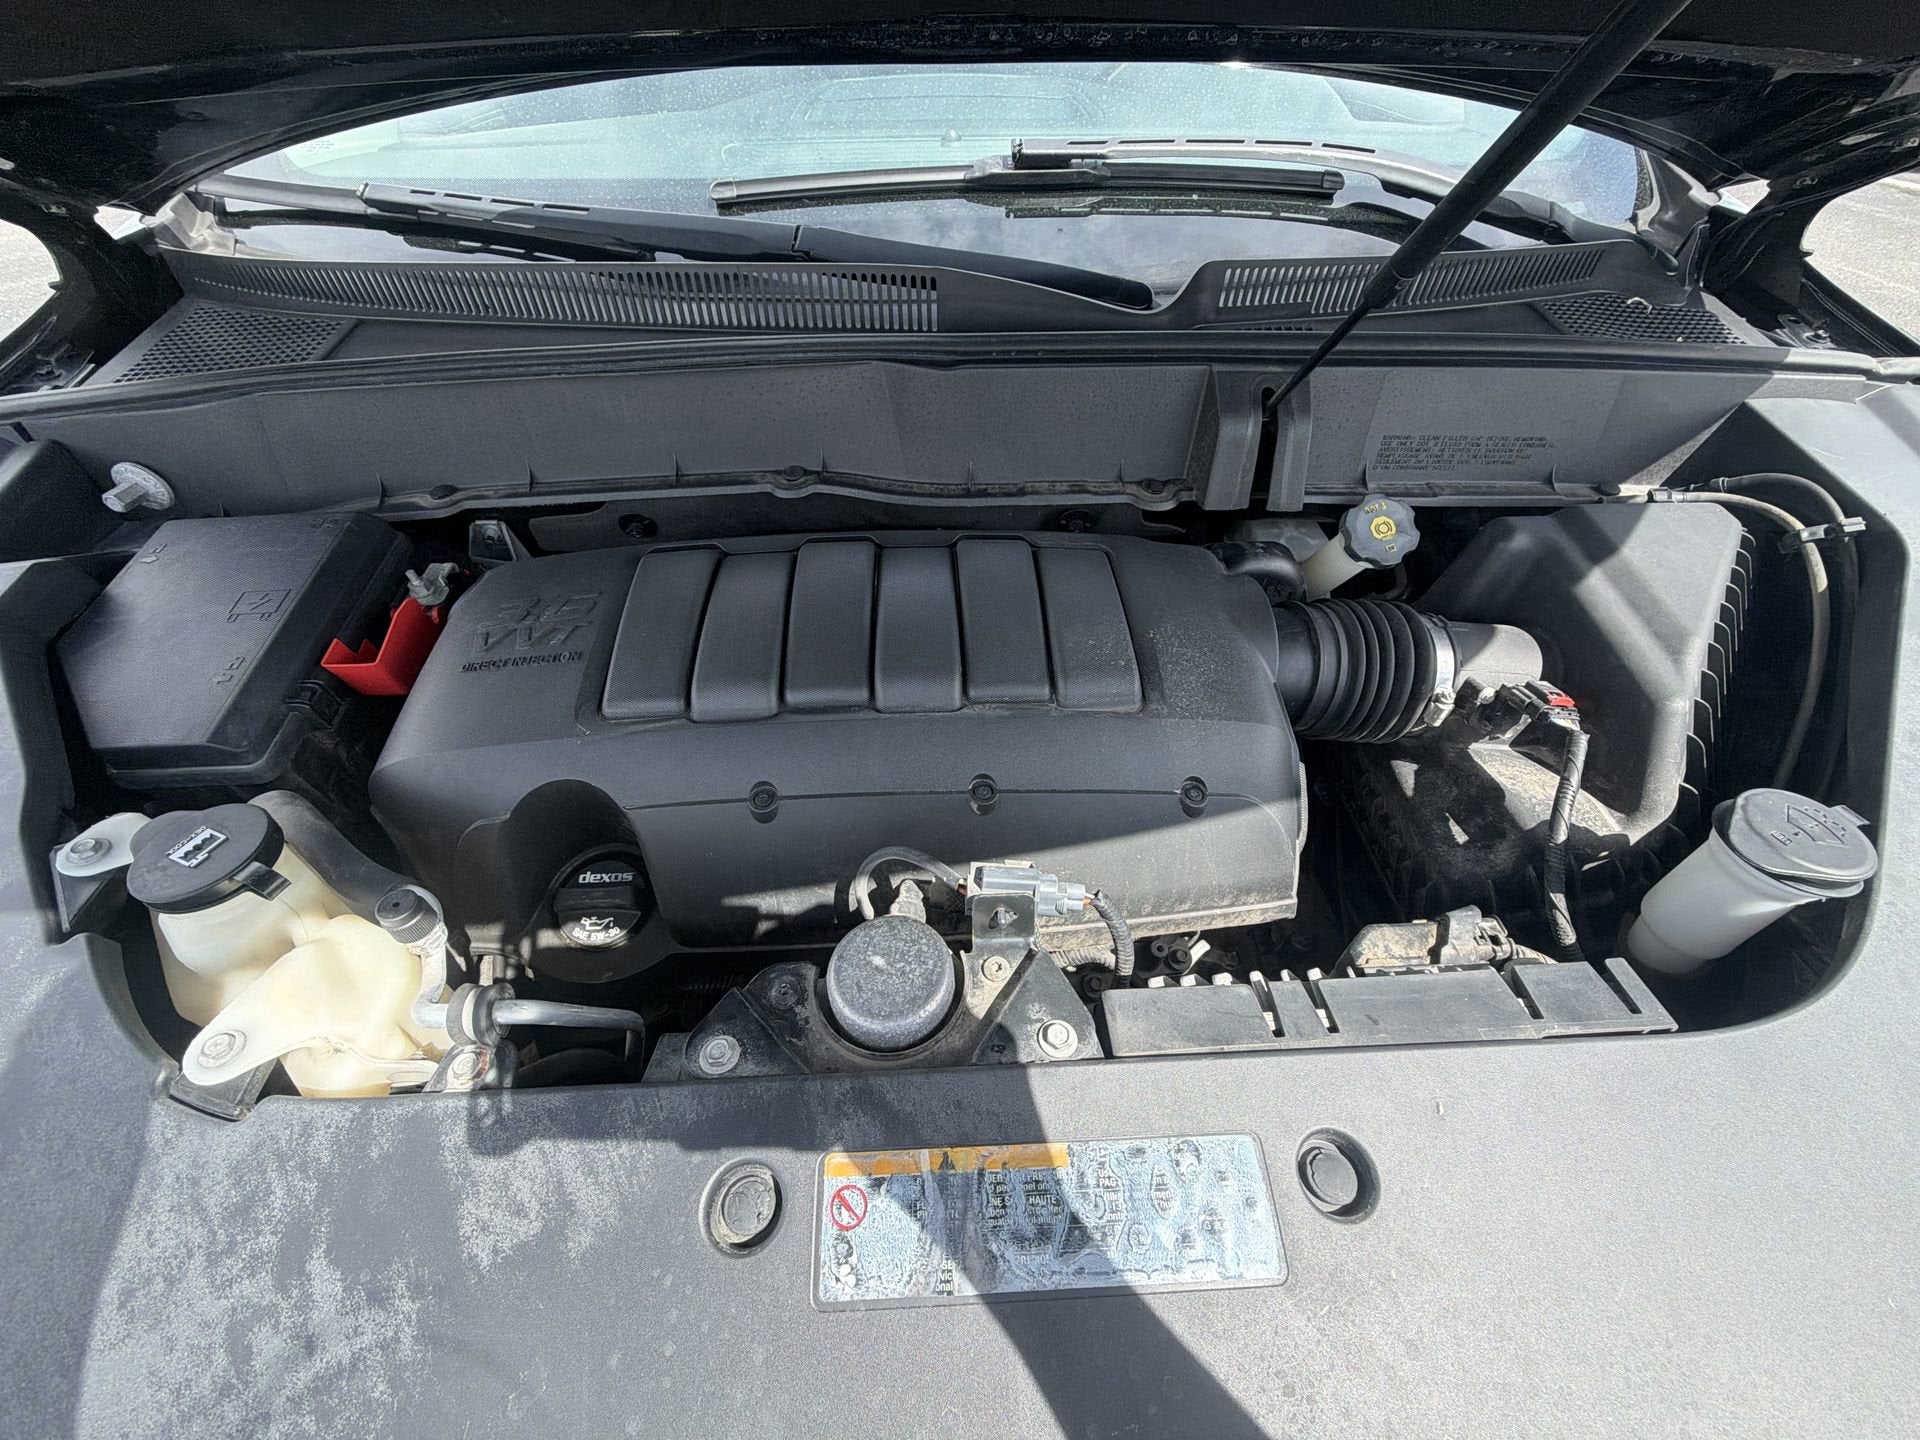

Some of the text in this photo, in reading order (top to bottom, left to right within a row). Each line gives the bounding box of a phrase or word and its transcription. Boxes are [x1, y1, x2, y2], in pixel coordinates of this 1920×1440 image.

[510, 650, 582, 667] INJECTION
[579, 871, 635, 884] dexos
[572, 926, 621, 941] SAE 5W-30
[1029, 1194, 1057, 1205] HAUTE
